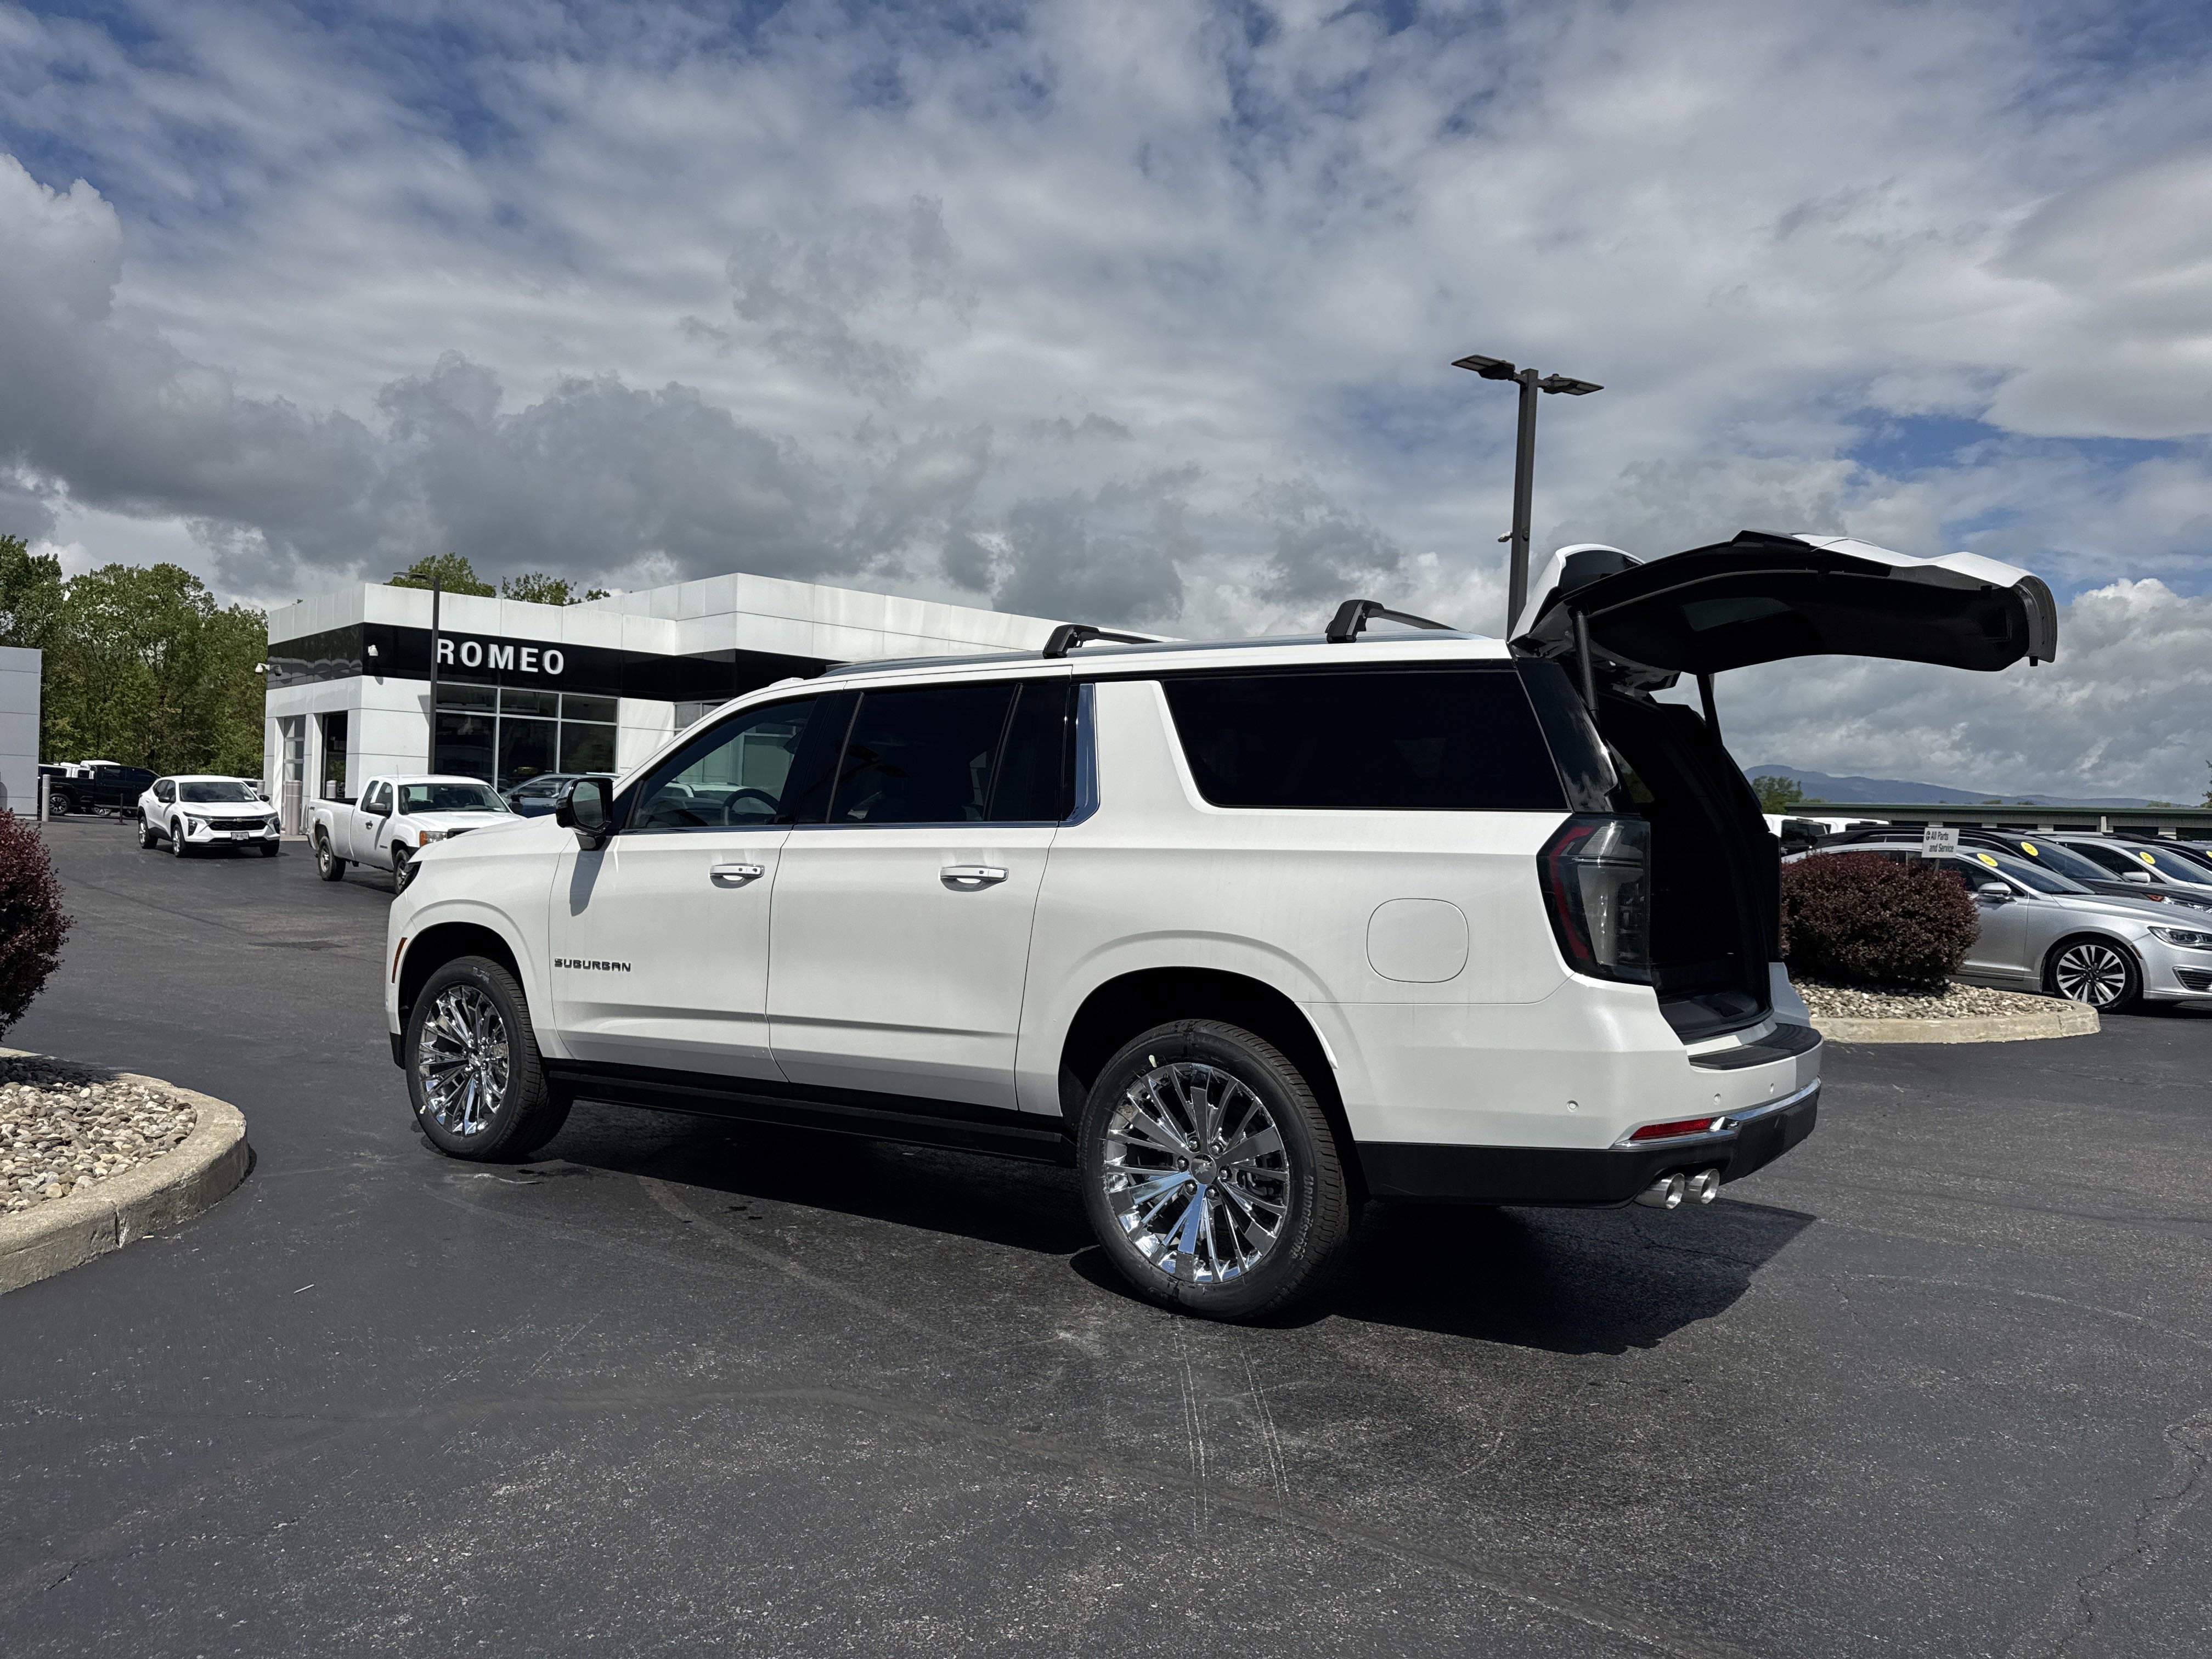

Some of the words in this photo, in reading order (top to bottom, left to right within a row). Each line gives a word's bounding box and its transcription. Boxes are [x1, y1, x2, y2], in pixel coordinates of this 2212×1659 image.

[437, 638, 564, 675] ROMEO
[1937, 831, 1949, 840] Parts
[1929, 843, 1938, 852] and
[1938, 843, 1954, 853] Service
[554, 958, 631, 972] SUBURBAN
[1289, 1173, 1314, 1261] BRIDGESTONE
